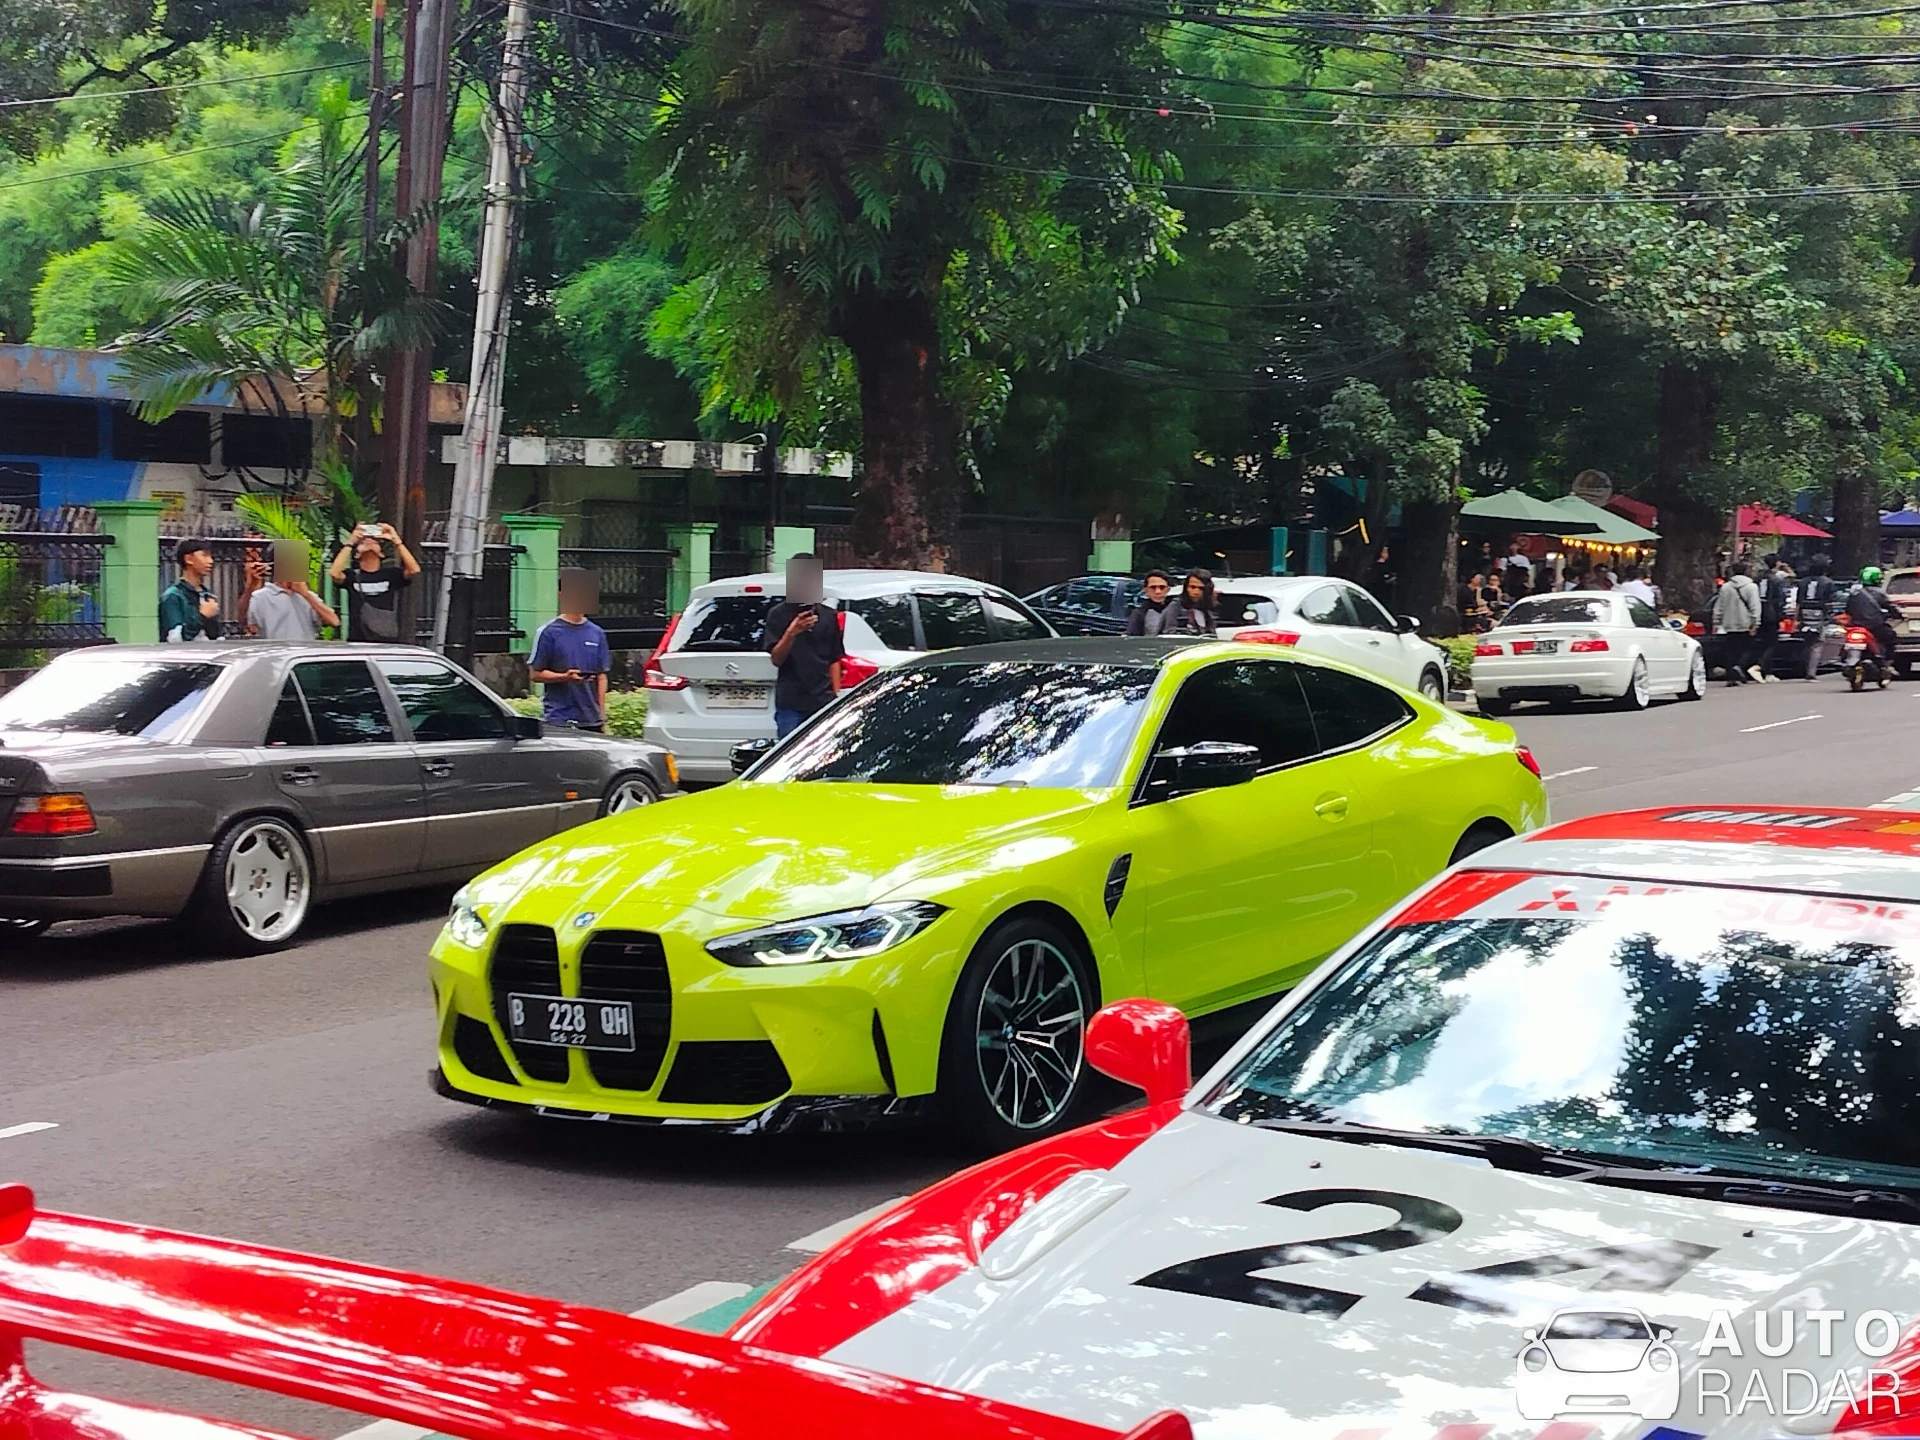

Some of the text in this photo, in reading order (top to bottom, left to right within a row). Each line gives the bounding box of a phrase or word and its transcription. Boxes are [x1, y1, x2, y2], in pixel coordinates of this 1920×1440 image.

[511, 999, 628, 1035] B 228 QH
